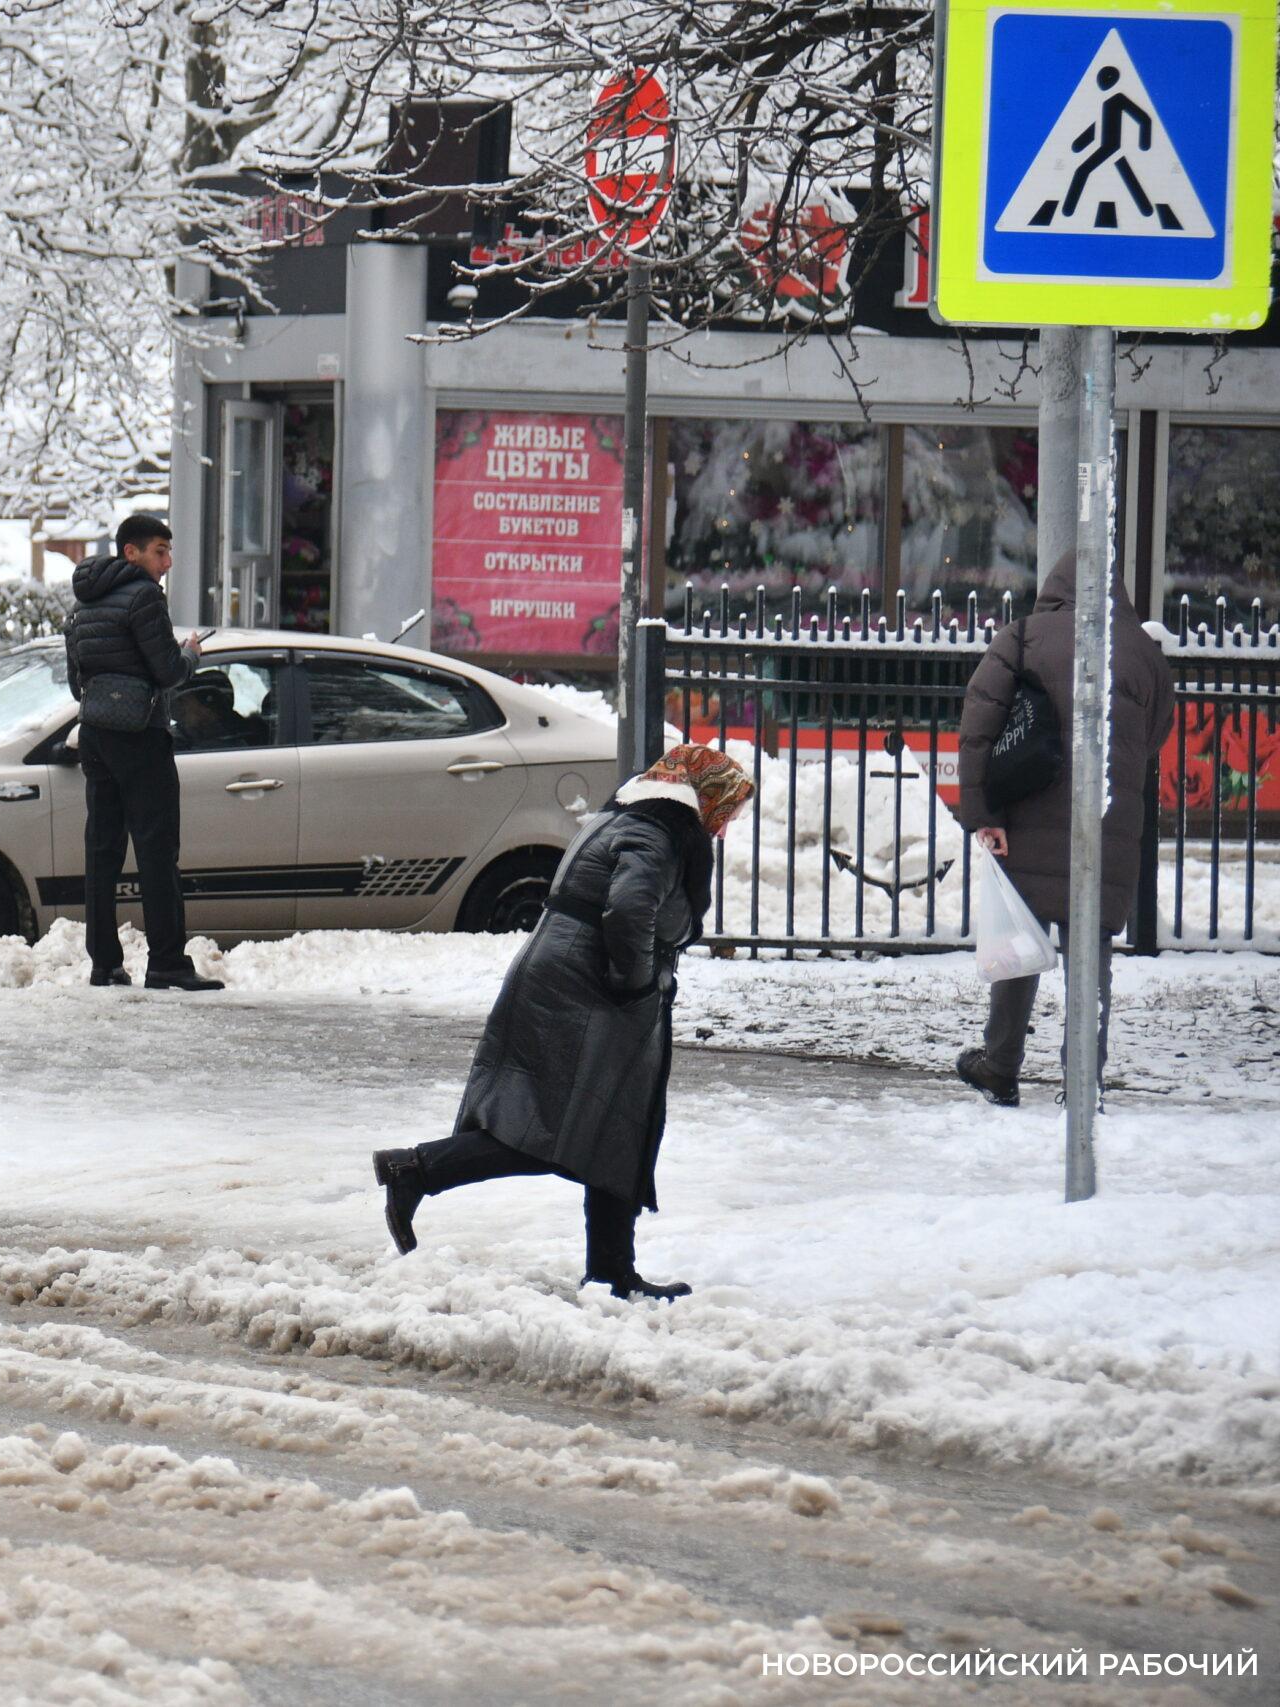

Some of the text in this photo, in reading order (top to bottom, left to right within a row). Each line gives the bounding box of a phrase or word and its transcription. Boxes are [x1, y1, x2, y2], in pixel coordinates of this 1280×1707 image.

[493, 424, 585, 449] ЖИВЫЕ
[486, 450, 590, 481] ЦВЕТЫ
[473, 491, 601, 514] СОСТАВЛЕНИЕ
[499, 517, 579, 536] БУКЕТОВ
[484, 552, 584, 573] ОТКРЫТКИ
[490, 598, 576, 619] ИГРУШКИ
[991, 720, 1025, 758] HAPPY
[116, 882, 140, 896] RI
